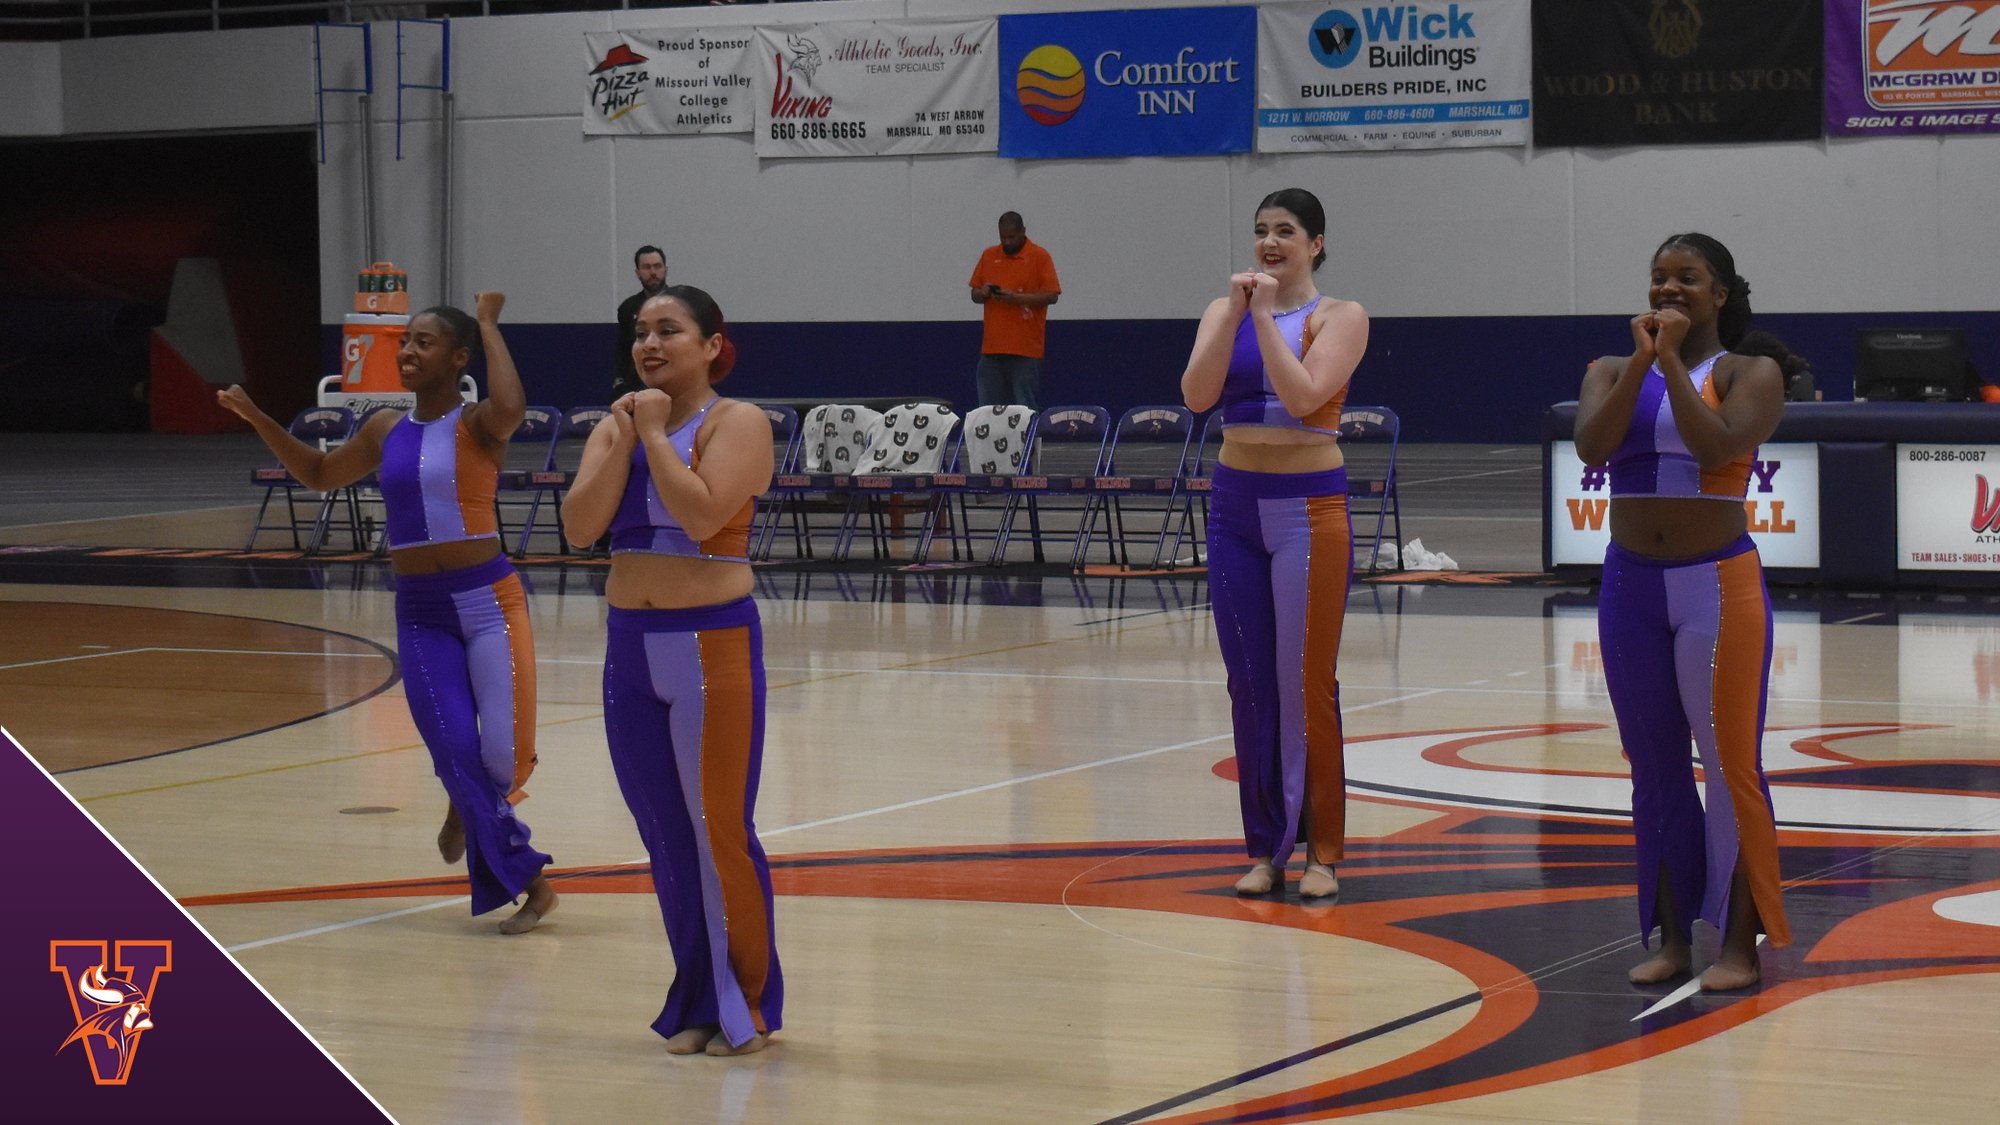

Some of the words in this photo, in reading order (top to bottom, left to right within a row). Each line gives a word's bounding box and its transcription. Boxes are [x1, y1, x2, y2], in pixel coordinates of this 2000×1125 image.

[1362, 3, 1476, 42] Wick
[658, 39, 694, 51] Proud
[699, 38, 749, 50] Sponsor
[828, 38, 891, 62] Athletic
[897, 35, 944, 60] Goods,
[950, 32, 983, 57] Inc.
[698, 57, 710, 69] of
[1369, 44, 1477, 71] Buildings
[865, 64, 891, 74] TEAM
[895, 62, 945, 73] SPECIALIST
[1094, 46, 1241, 86] Comfort
[655, 75, 708, 89] Missouri
[713, 73, 752, 89] Valley
[1544, 73, 1641, 97] WOOD
[1680, 67, 1816, 93] HUSTON
[1869, 71, 1976, 88] McGRAW
[1301, 82, 1388, 98] BUILDERS
[1393, 80, 1451, 95] PRIDE,
[1457, 78, 1487, 92] INC
[680, 95, 728, 108] College
[1137, 89, 1196, 116] INN
[677, 113, 733, 125] Athletics
[915, 112, 926, 122] 74
[930, 111, 950, 121] WEST
[954, 109, 984, 120] ARROW
[1267, 112, 1289, 124] 1211
[1304, 110, 1351, 123] MORROW
[1364, 107, 1435, 121] 660-886-4600
[1507, 103, 1523, 116] MO
[1634, 101, 1718, 124] BANK
[1845, 116, 1897, 127] SIGN
[1900, 115, 1914, 126] &
[1919, 113, 1988, 126] IMAGE
[771, 121, 867, 140] 660-886-6665
[939, 125, 952, 135] MO
[955, 123, 985, 135] 65340
[1290, 133, 1349, 143] COMMERCIAL
[1363, 132, 1388, 141] FARM
[1402, 131, 1437, 141] EQUINE
[1451, 128, 1502, 138] SUBURBAN
[1909, 450, 1986, 462] 800-286-0087
[1912, 552, 1932, 562] TEAM
[1934, 552, 1957, 562] SALES
[1963, 553, 1987, 563] SHOES
